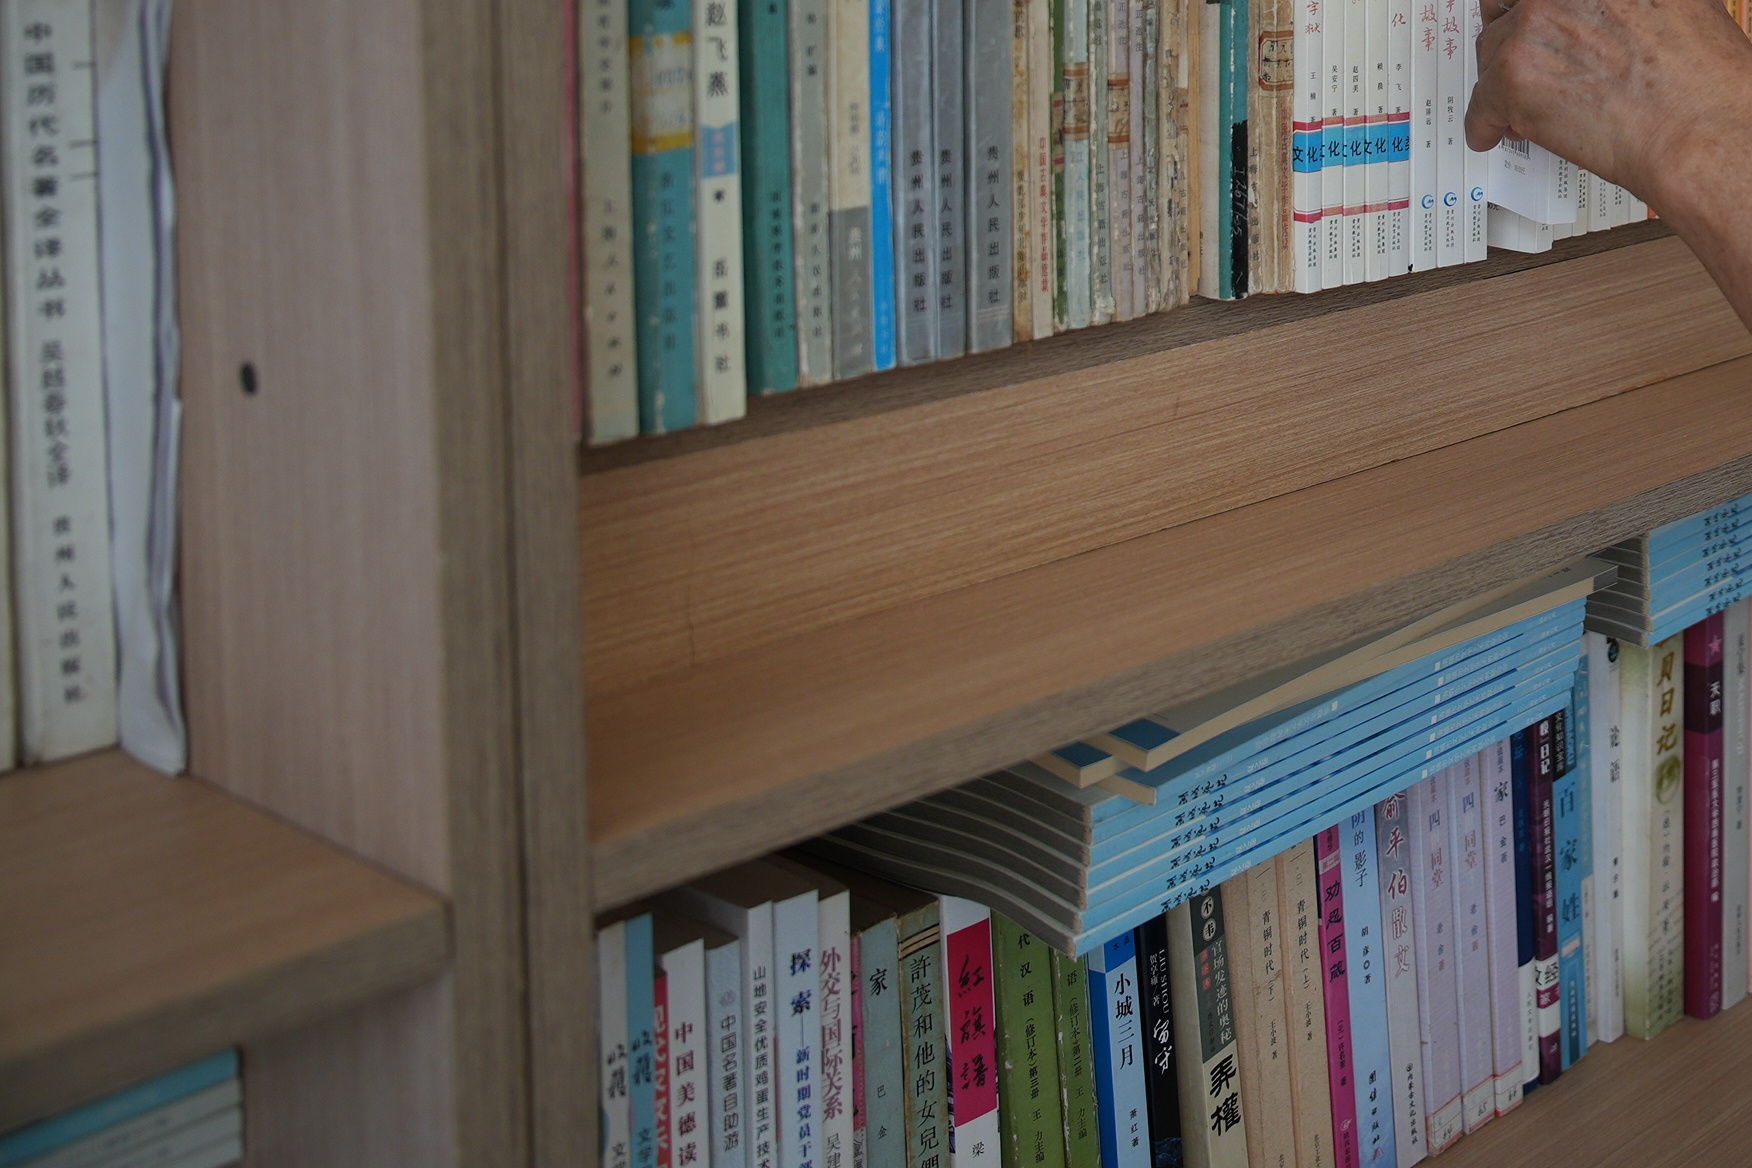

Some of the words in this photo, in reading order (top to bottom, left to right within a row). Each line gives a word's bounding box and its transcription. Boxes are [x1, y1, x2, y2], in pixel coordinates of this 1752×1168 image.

[910, 149, 930, 313] 贵州人民出版社
[940, 148, 955, 311] 贵州人民出版社
[986, 145, 1002, 306] 贵州人民出版社
[1557, 782, 1580, 923] 百家姓
[820, 947, 844, 1123] 外交与国际关系
[869, 968, 888, 996] 家
[1114, 972, 1136, 1071] 小城三月
[1210, 941, 1233, 1046] 官场发迹的奥秘
[720, 1015, 740, 1153] 中国名著自助游
[1208, 1053, 1243, 1136] 弄權
